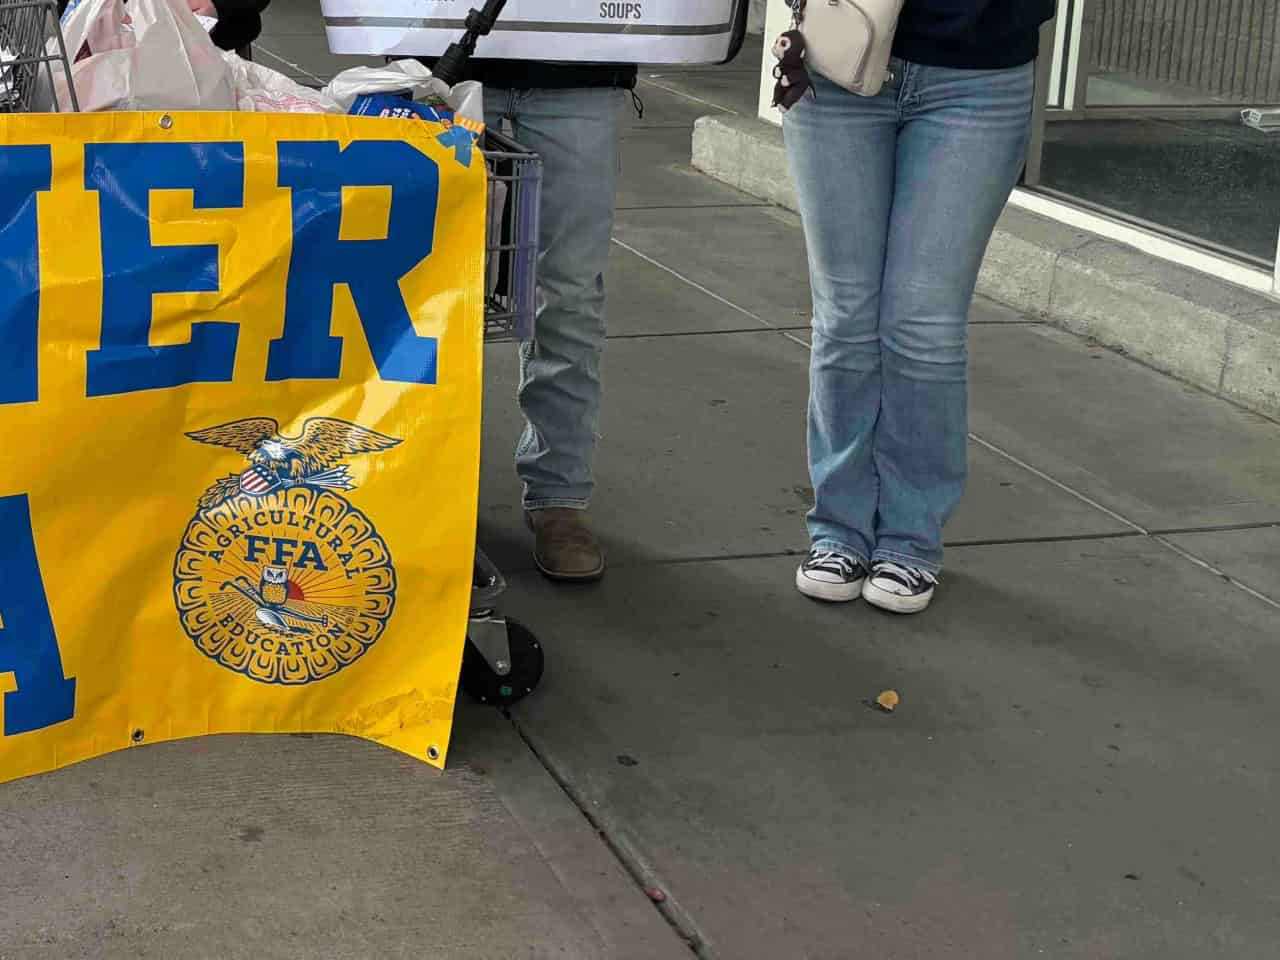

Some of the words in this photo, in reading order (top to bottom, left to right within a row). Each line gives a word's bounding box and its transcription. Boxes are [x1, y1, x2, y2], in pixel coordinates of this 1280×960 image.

[599, 2, 642, 19] SOUPS
[206, 510, 363, 579] AGRICULTURAL
[243, 534, 329, 571] FFA
[218, 612, 346, 657] EDUCATION
